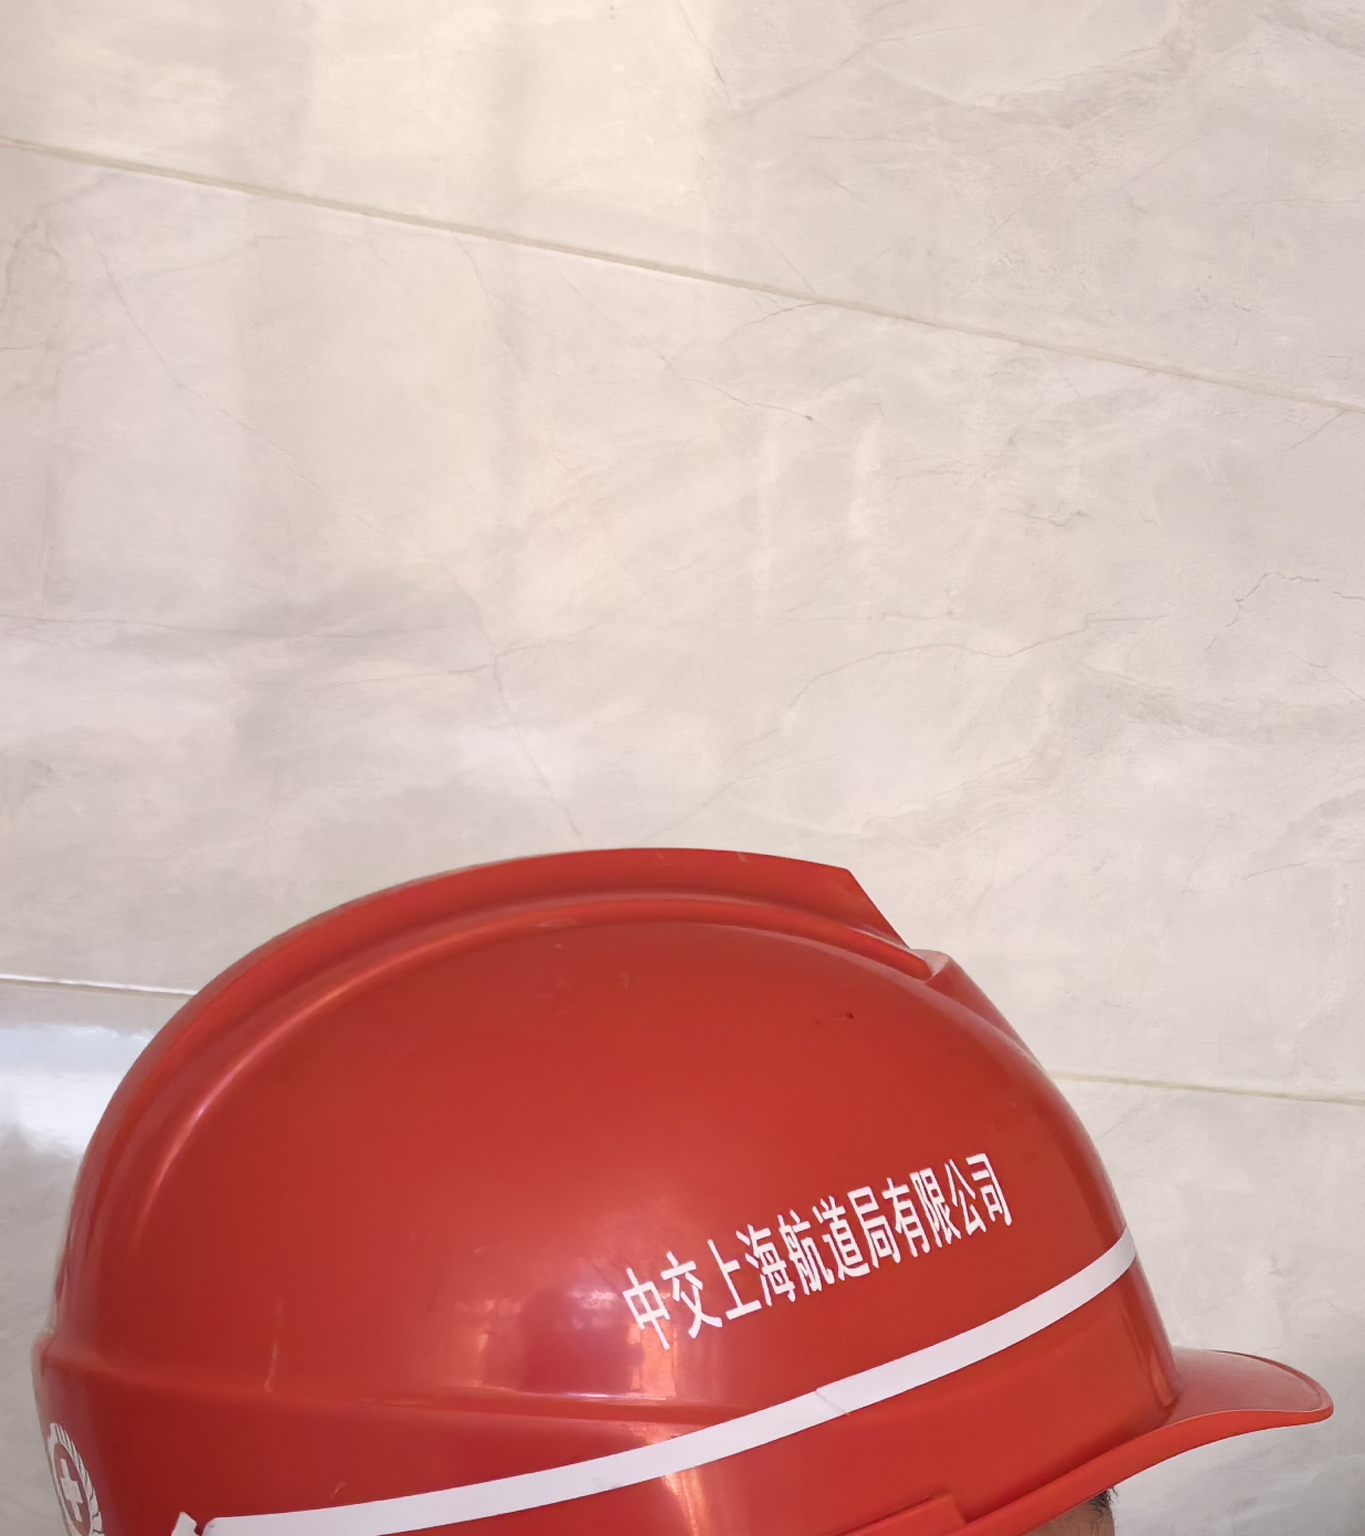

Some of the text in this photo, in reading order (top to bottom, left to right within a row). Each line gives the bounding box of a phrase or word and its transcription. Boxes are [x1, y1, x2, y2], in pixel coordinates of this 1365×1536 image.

[622, 1152, 1012, 1350] 中交上海航道局有限公司
